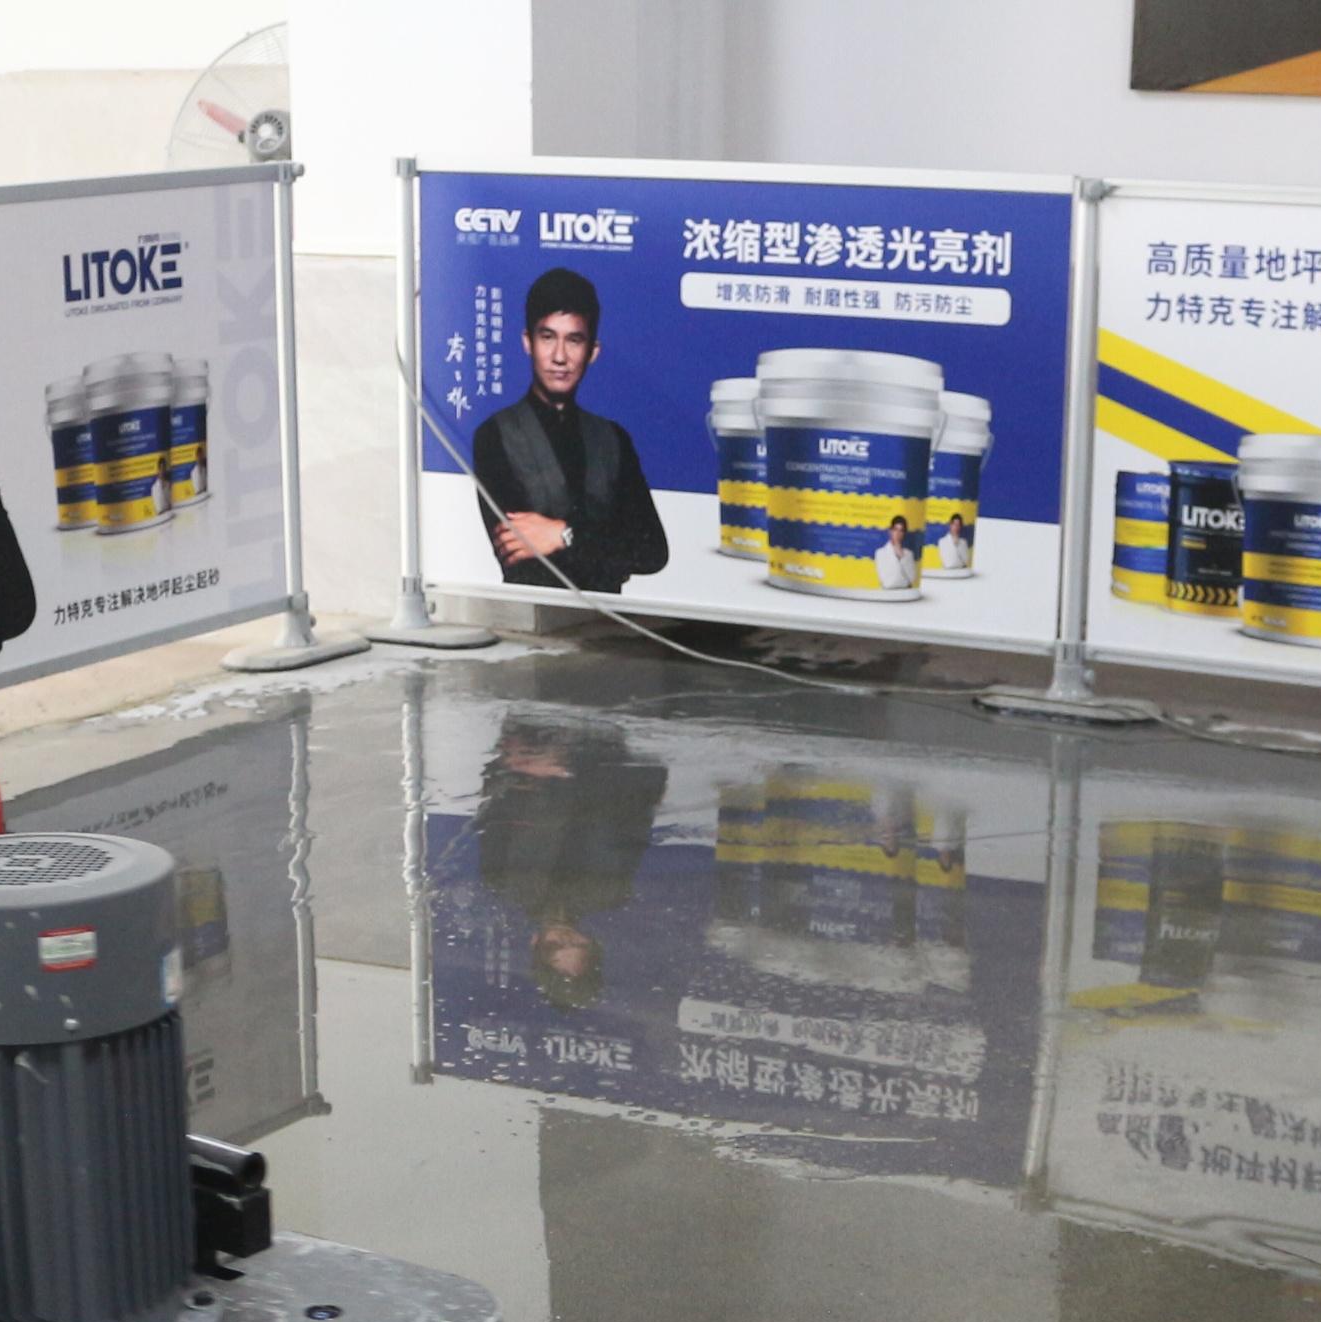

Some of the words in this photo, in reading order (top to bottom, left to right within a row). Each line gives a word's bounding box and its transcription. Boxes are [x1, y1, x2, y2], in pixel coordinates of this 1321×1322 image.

[454, 207, 522, 233] CCTV
[539, 212, 634, 244] LITOKE
[682, 218, 1012, 277] 浓缩型渗透光亮剂
[63, 242, 183, 303] LITOKE
[716, 281, 790, 304] 增亮防滑
[804, 286, 881, 311] 耐磨性强
[893, 291, 974, 317] 防污防尘
[819, 437, 871, 457] LITOKE
[53, 567, 221, 627] 力特克专注解决地坪起尘起砂
